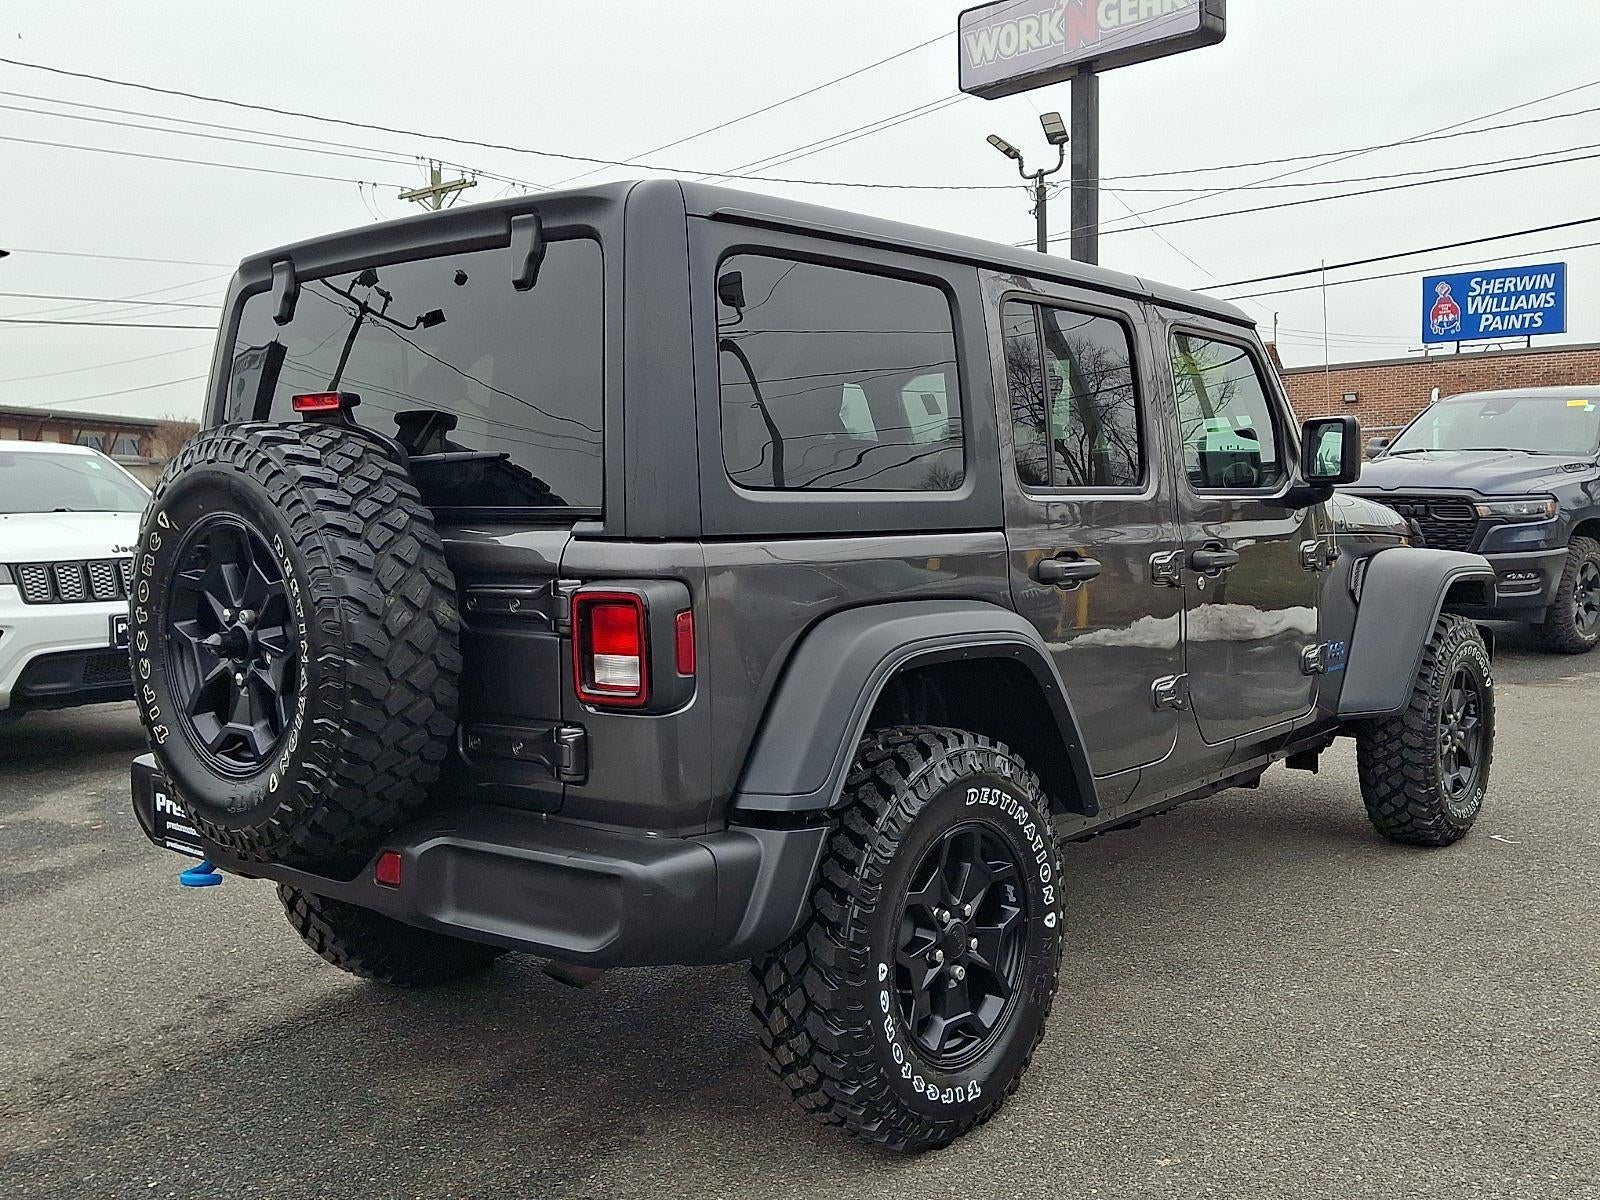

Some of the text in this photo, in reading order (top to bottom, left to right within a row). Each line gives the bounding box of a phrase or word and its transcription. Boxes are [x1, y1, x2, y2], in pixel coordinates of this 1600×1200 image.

[964, 7, 1066, 68] WORK
[1467, 292, 1556, 315] WILLIAMS
[1468, 272, 1556, 297] SHERWIN
[1479, 312, 1544, 333] PAINTS
[273, 533, 309, 776] DESTINATION
[965, 787, 1055, 906] DESTINATION
